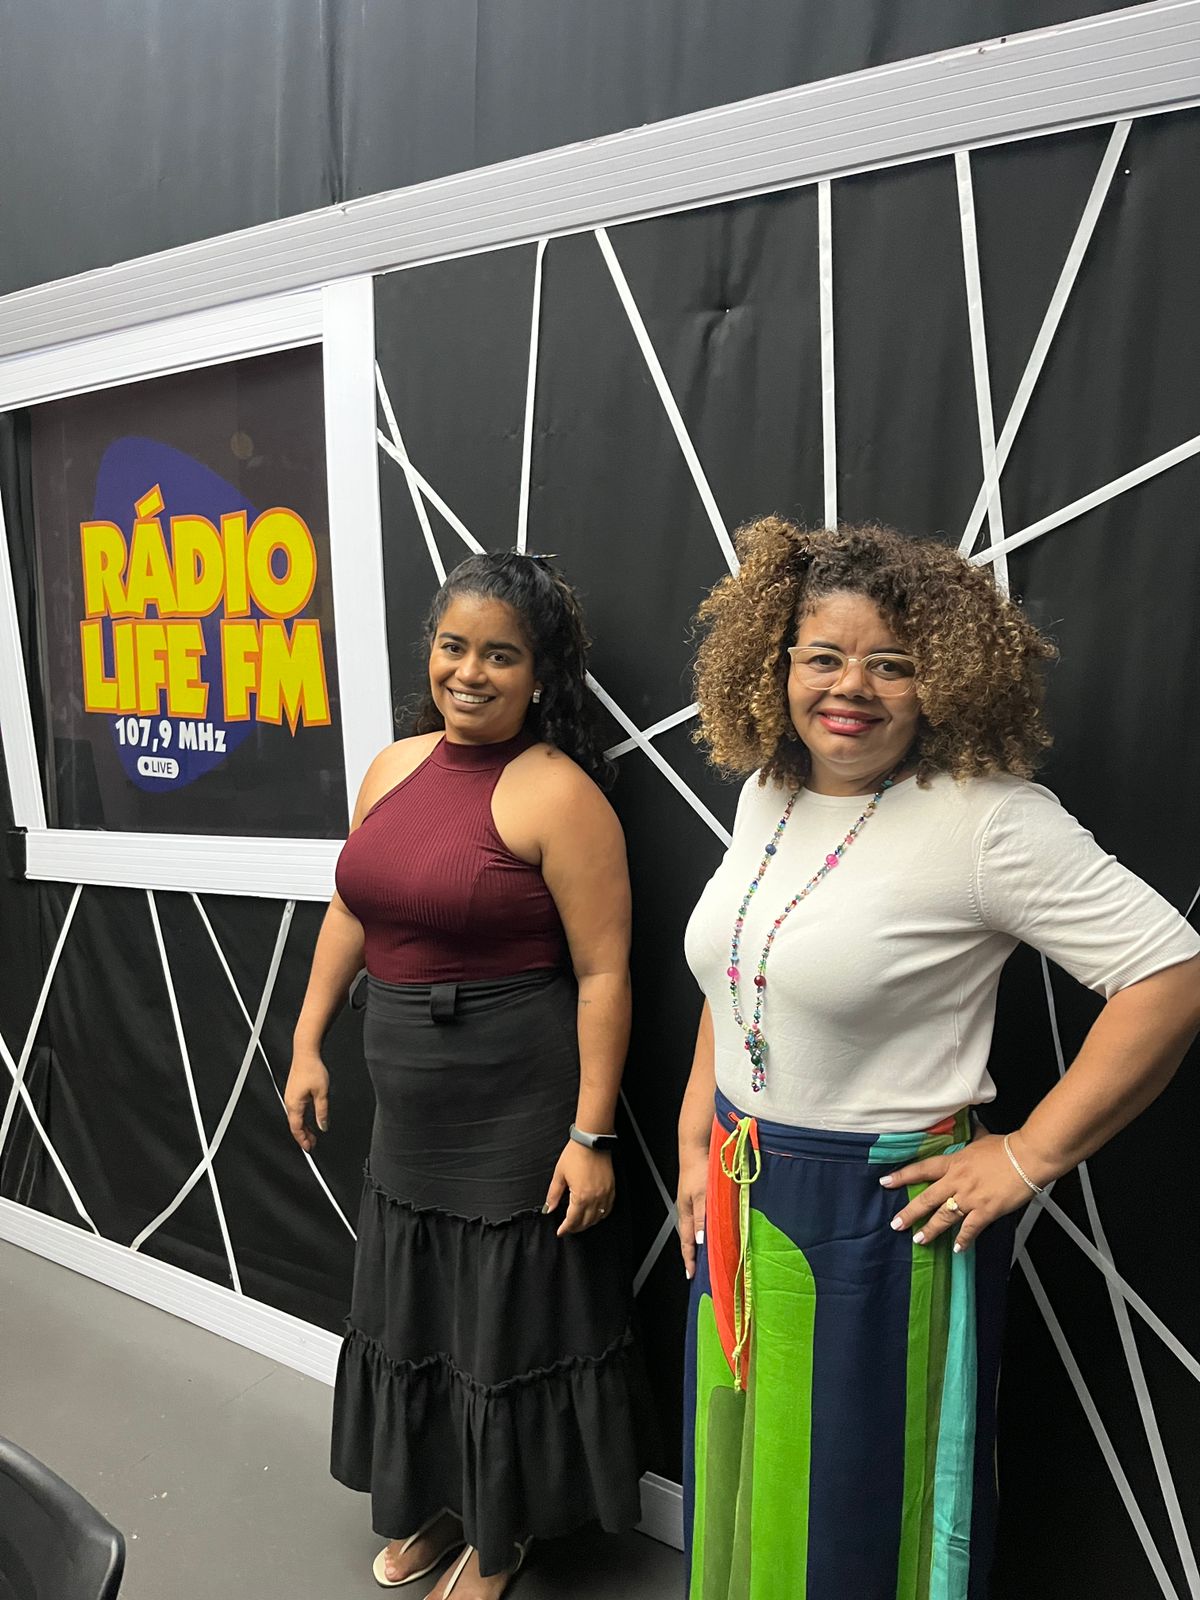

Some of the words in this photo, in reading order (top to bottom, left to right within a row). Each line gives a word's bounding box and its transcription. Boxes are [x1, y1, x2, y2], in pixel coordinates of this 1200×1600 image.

[80, 483, 317, 619] RÁDIO
[80, 618, 209, 719] LIFE
[220, 618, 331, 737] FM
[115, 717, 172, 752] 107,9
[179, 722, 227, 753] MHz
[151, 760, 173, 774] LIVE
